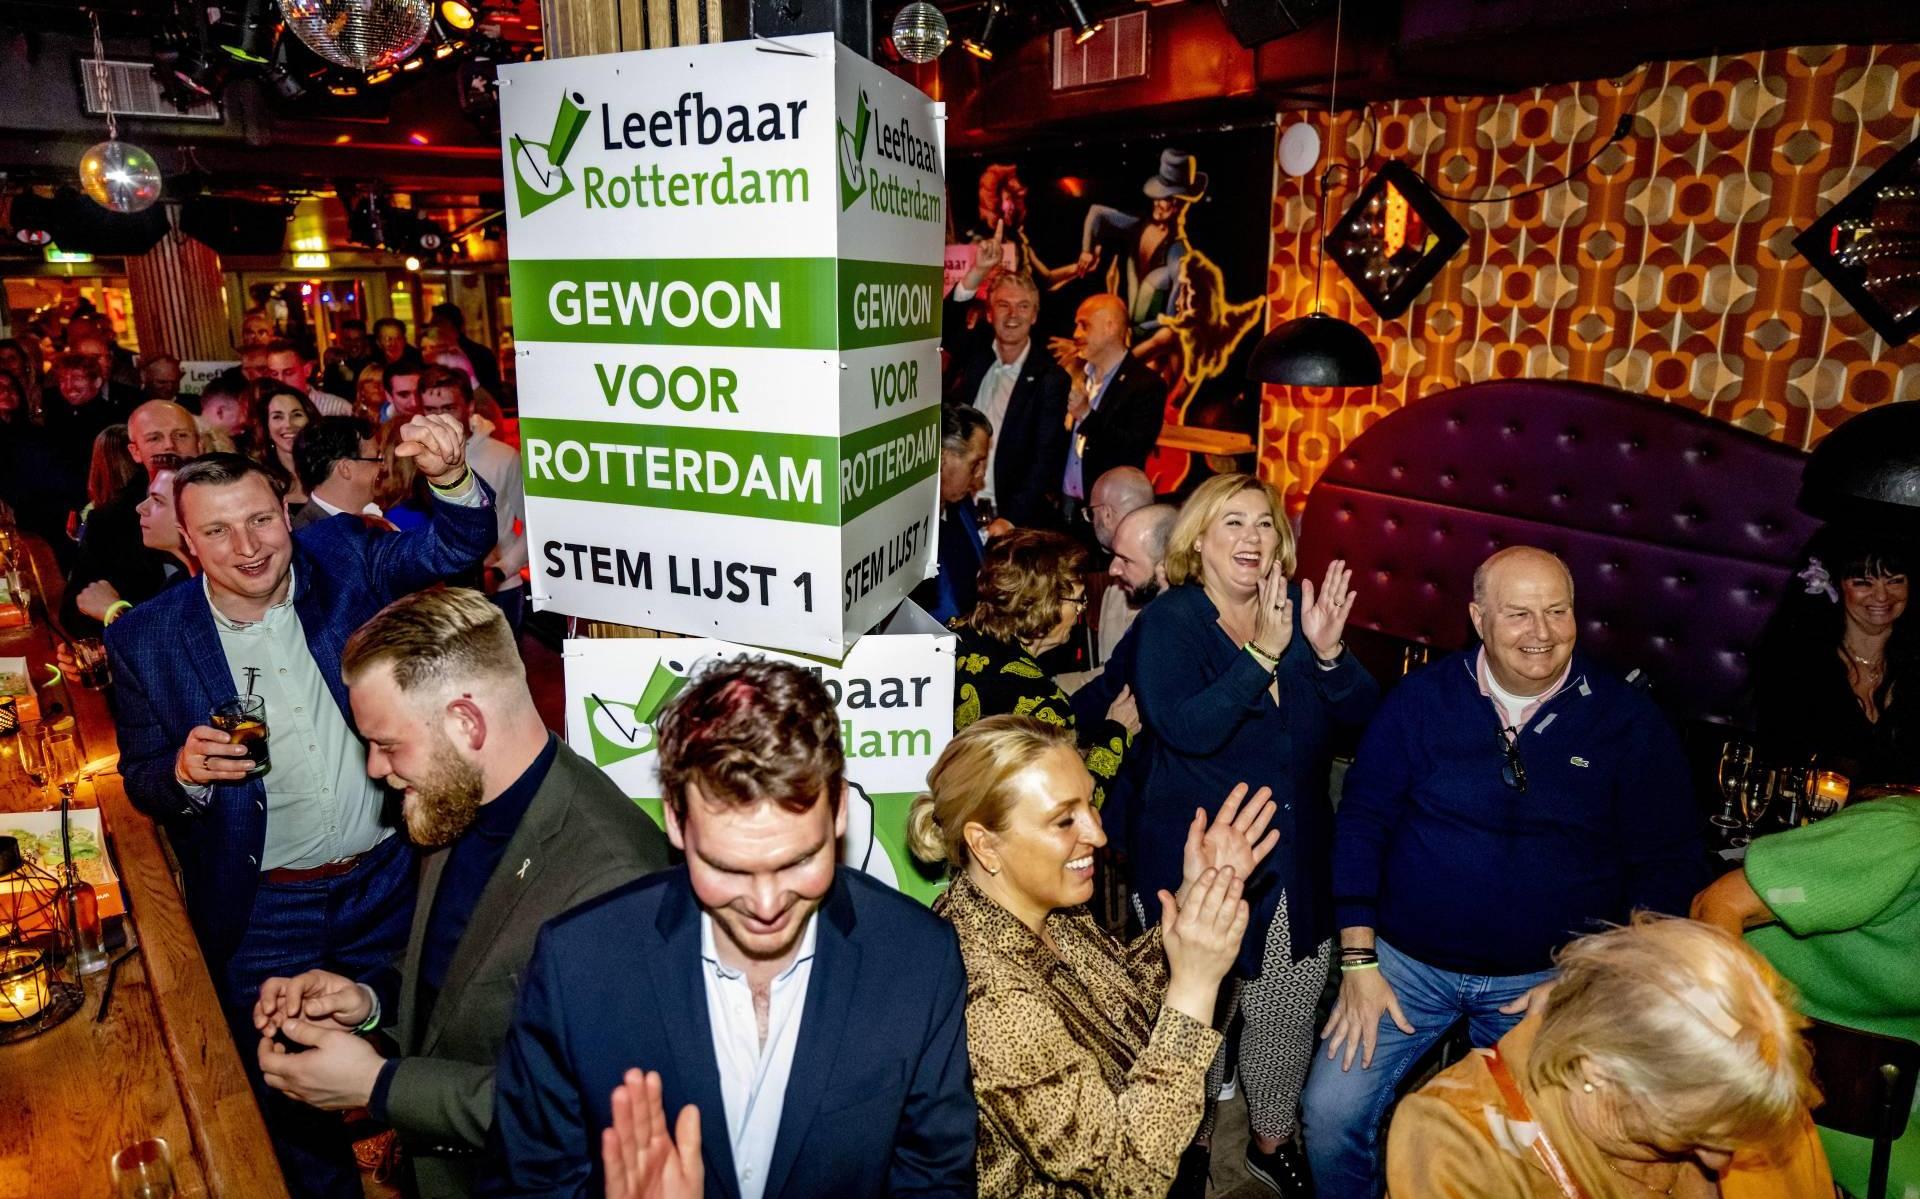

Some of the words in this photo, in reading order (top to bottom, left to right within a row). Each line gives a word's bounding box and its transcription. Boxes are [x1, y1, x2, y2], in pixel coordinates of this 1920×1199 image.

[602, 92, 807, 150] Leefbaar
[875, 108, 936, 173] Leefbaar
[584, 157, 809, 209] Rotterdam
[870, 167, 941, 222] Rotterdam
[549, 281, 781, 328] GEWOON
[854, 283, 931, 330] GEWOON
[594, 364, 739, 413] VOOR
[871, 360, 917, 408] VOOR
[526, 438, 822, 504] ROTTERDAM
[841, 424, 936, 504] ROTTERDAM
[543, 540, 652, 590] STEM
[669, 555, 776, 606] LIJST
[793, 572, 813, 612] 1
[845, 546, 884, 612] STEM
[888, 521, 920, 576] LIJST
[923, 515, 929, 547] 1
